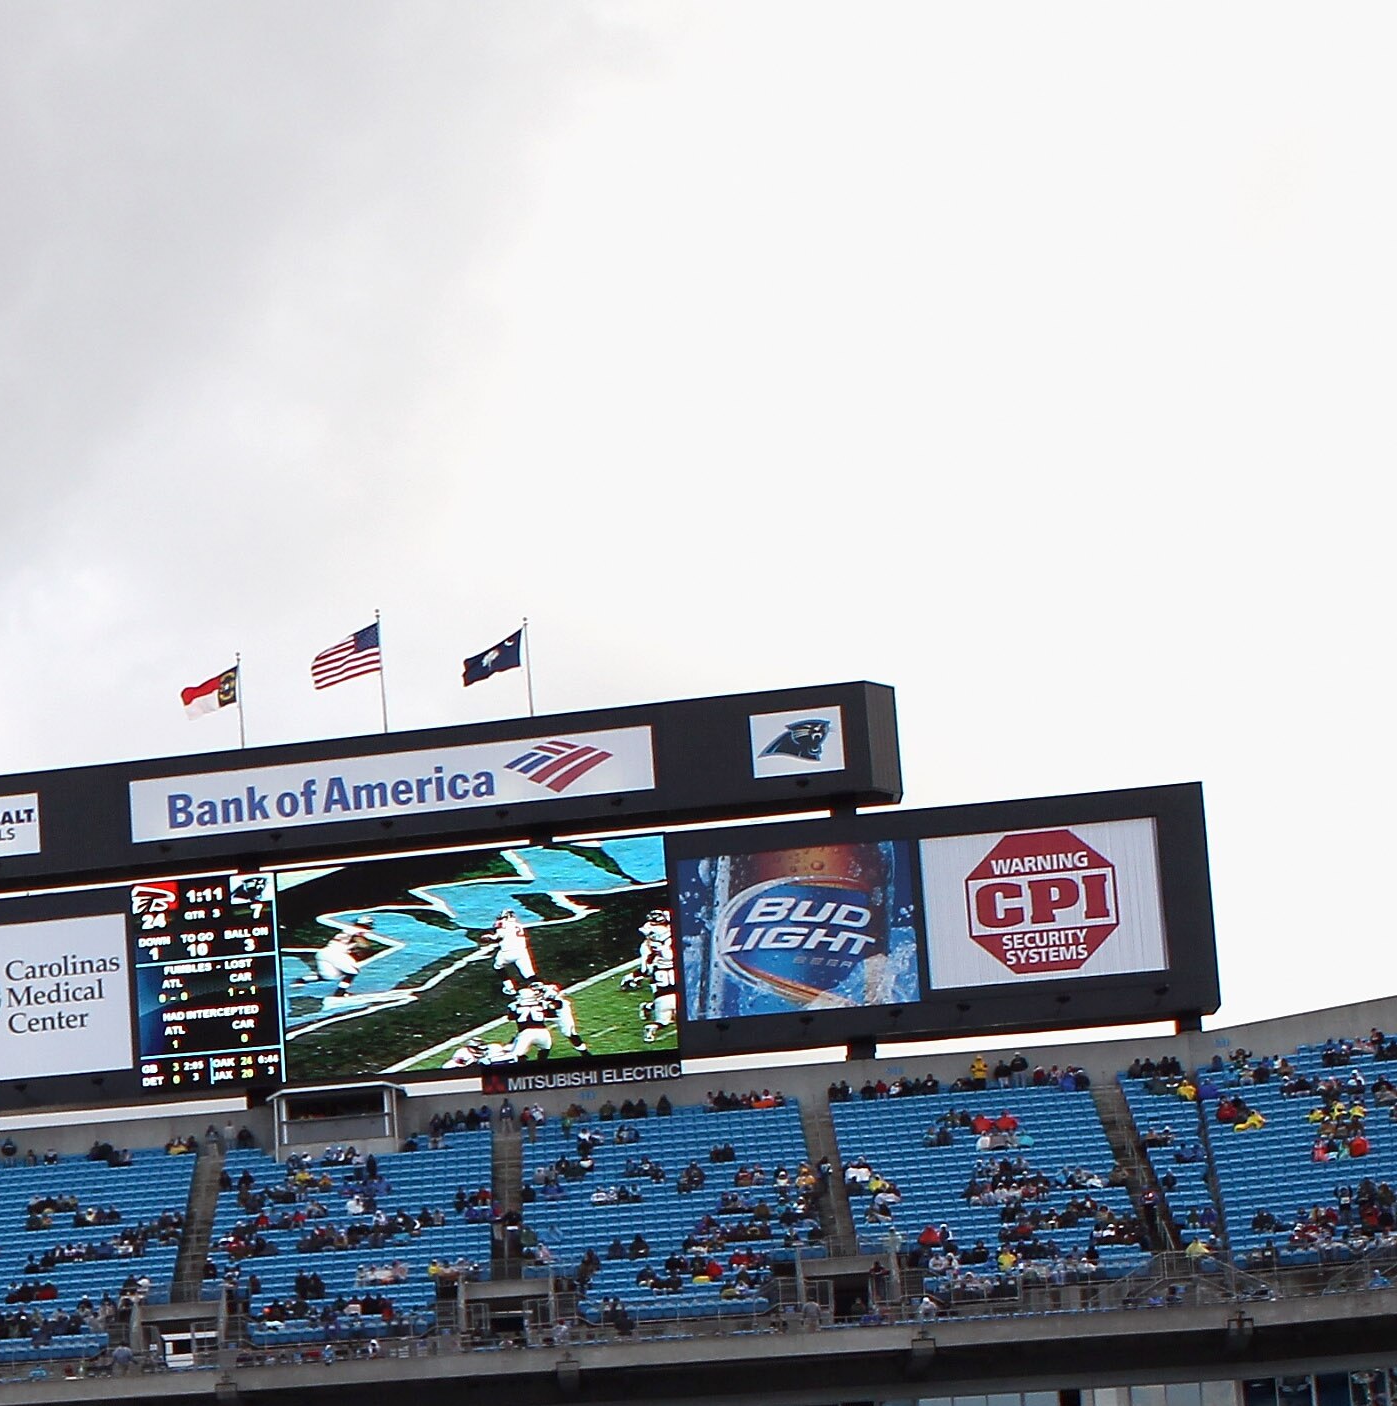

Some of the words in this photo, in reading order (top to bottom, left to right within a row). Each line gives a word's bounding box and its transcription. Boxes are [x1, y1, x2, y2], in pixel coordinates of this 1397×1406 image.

[167, 786, 270, 830] Bank
[276, 779, 318, 817] of
[323, 766, 496, 812] America
[990, 851, 1089, 876] WARNING
[186, 887, 223, 903] 1:11
[975, 873, 1110, 929] CPI
[184, 910, 206, 921] QTR
[211, 908, 221, 919] 3
[250, 903, 263, 919] 7
[744, 897, 874, 928] BUD
[141, 913, 167, 930] 24
[180, 933, 196, 944] TO
[197, 932, 215, 942] GO
[224, 929, 251, 940] BALL
[252, 927, 269, 937] ON
[722, 925, 876, 956] LIGHT
[1001, 928, 1088, 951] SECURITY
[138, 936, 171, 948] DOWN
[244, 938, 256, 952] 3
[148, 947, 159, 961] 1
[186, 944, 209, 957] 10
[1005, 945, 1088, 966] SYSTEMS
[5, 954, 120, 983] Carolinas
[163, 962, 212, 976] FUMBLES
[224, 958, 253, 970] LOST
[161, 979, 184, 990] ATL
[229, 972, 253, 983] CAR
[6, 979, 105, 1008] Medical
[8, 1009, 89, 1034] Center
[162, 1010, 185, 1022] HAD
[186, 1005, 259, 1020] INTERCEPTED
[518, 1006, 544, 1022] 76
[164, 1025, 186, 1036] ATL
[231, 1019, 255, 1030] CAR
[212, 1057, 236, 1068] OAK
[142, 1075, 164, 1087] DET
[212, 1070, 234, 1081] JAX
[508, 1071, 598, 1091] MITSUBISHI
[602, 1064, 681, 1083] ELECTRIC
